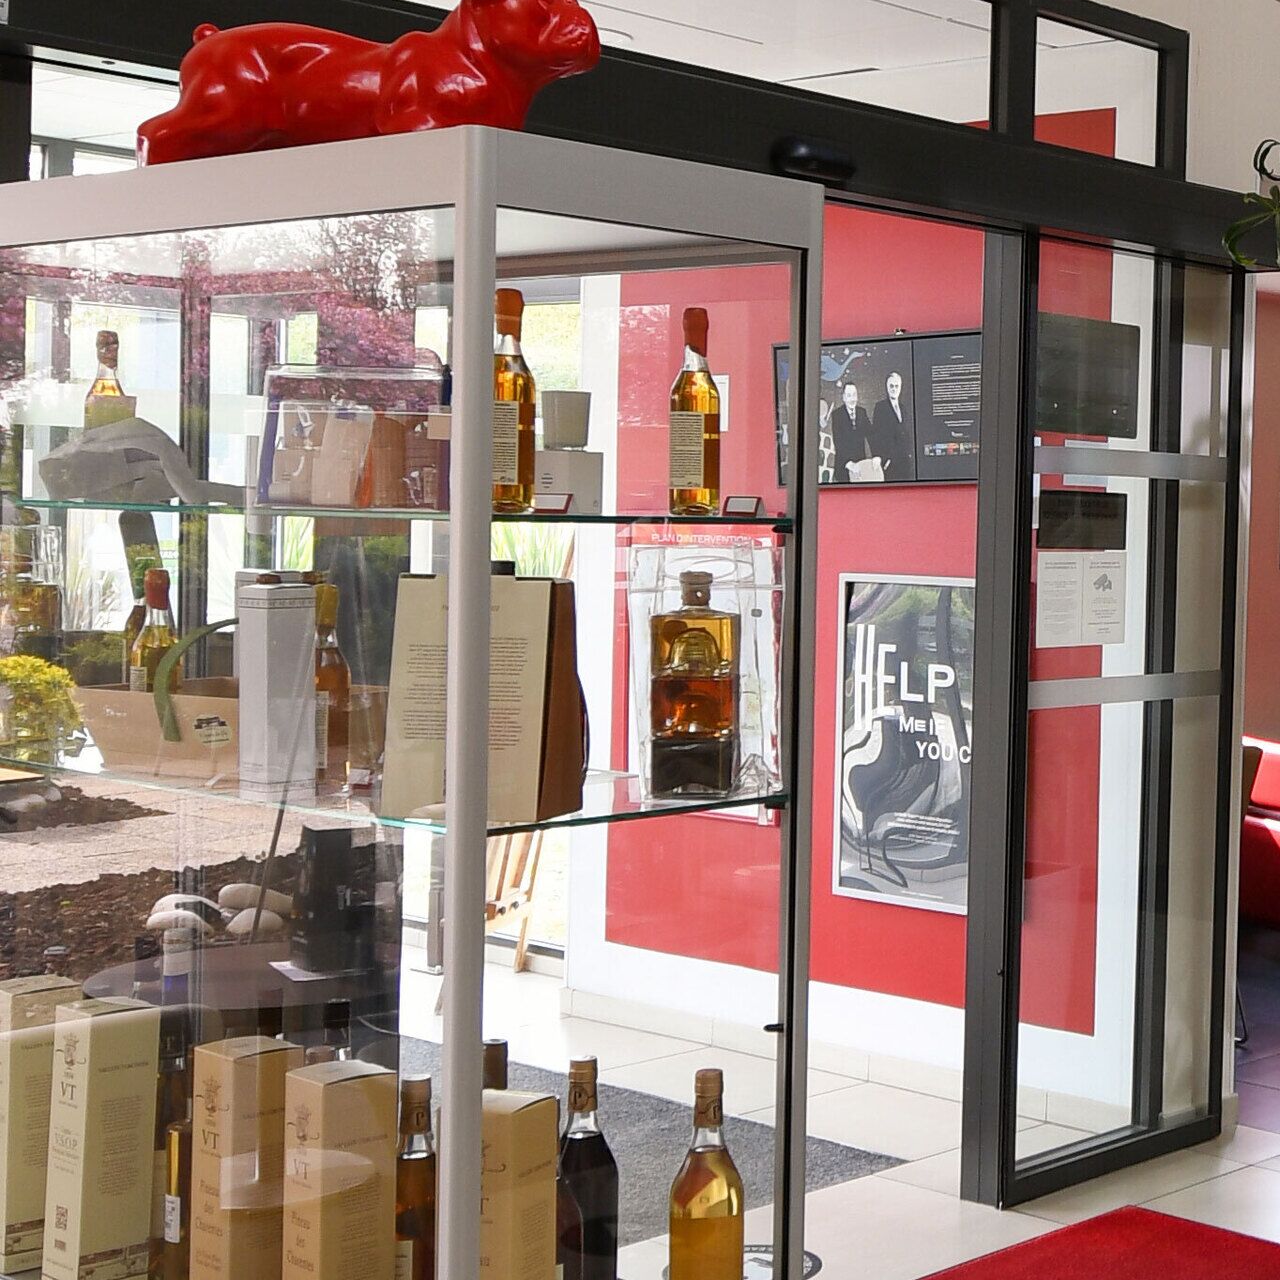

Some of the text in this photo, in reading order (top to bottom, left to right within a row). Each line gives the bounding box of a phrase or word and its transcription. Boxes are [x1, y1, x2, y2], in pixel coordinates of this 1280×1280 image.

[651, 533, 675, 542] PLAN
[854, 624, 955, 731] HELP
[916, 741, 954, 762] YOU
[60, 1082, 77, 1100] VT
[201, 1129, 220, 1150] VT
[293, 1158, 311, 1180] VT
